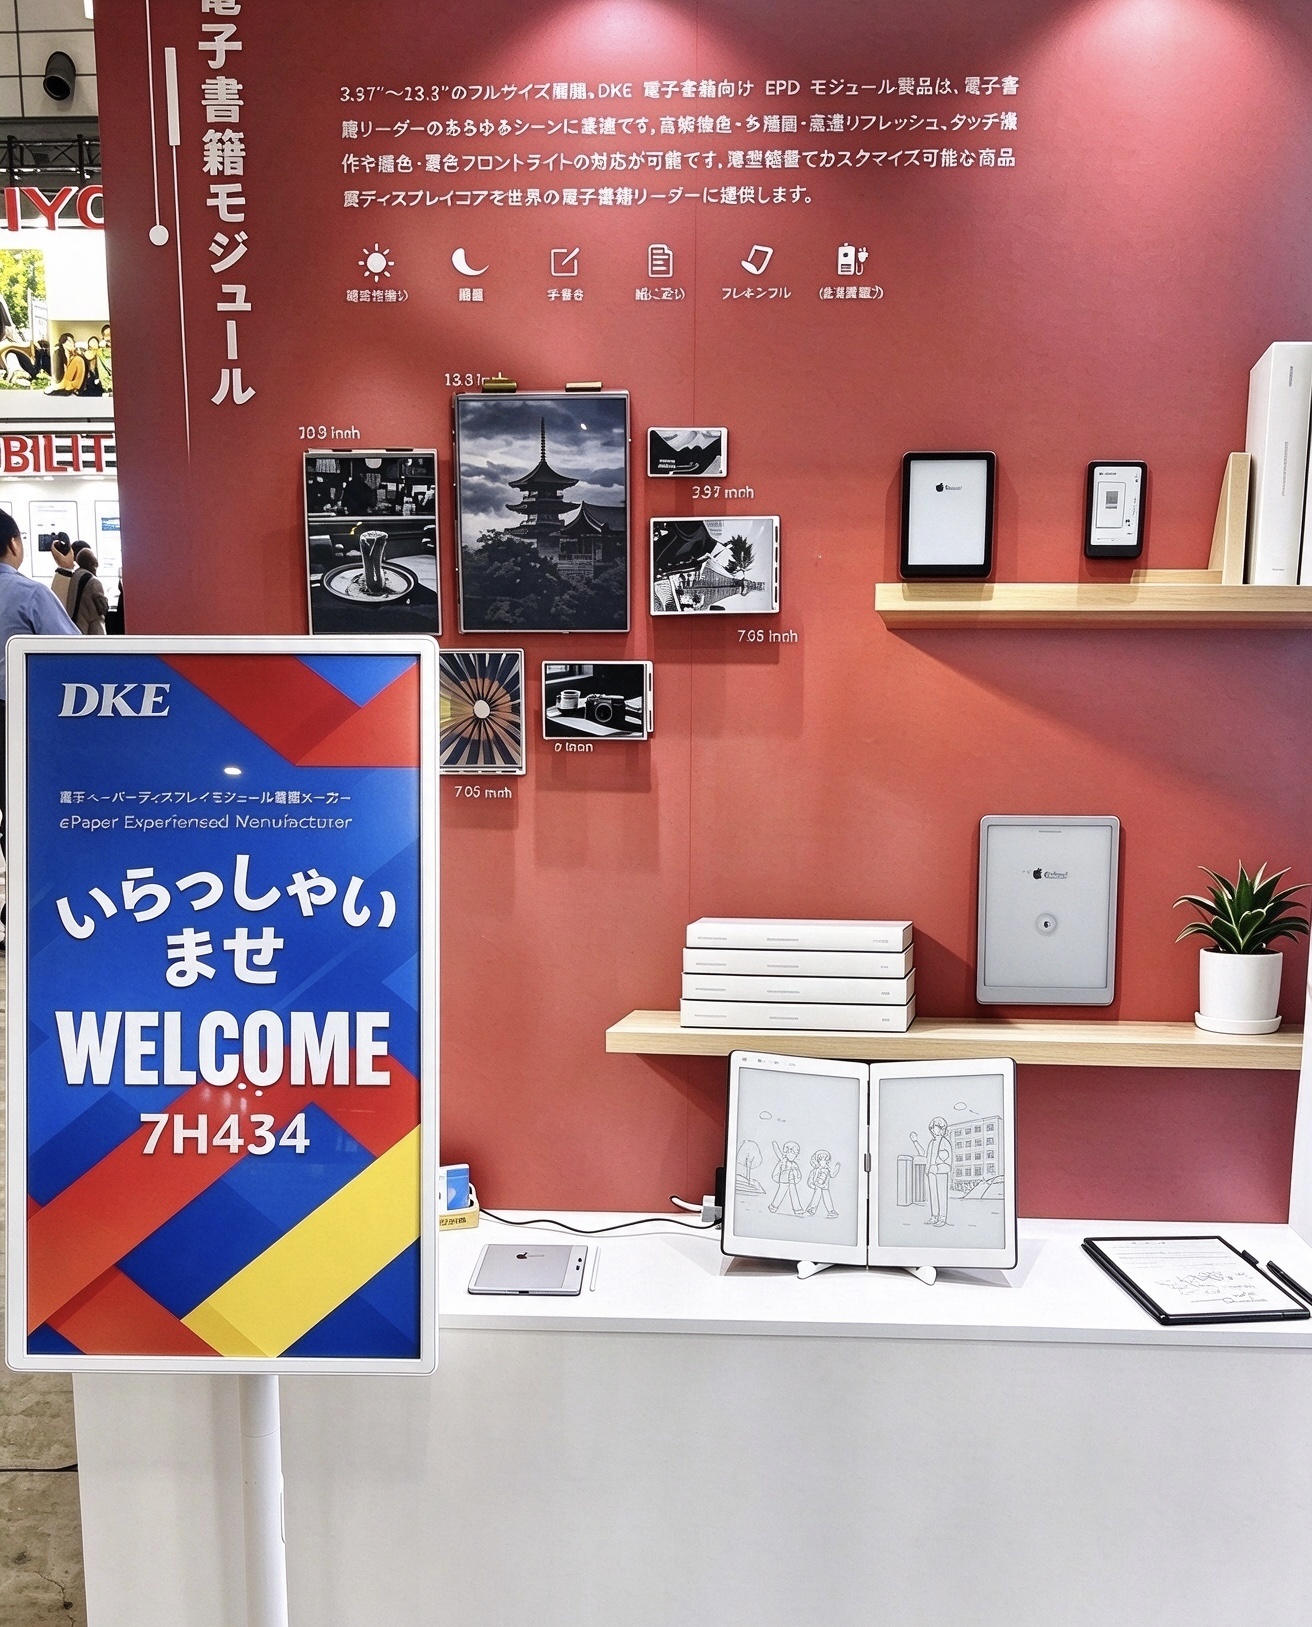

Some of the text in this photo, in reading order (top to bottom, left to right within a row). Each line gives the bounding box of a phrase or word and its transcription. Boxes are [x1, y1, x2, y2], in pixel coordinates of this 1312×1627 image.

[766, 80, 801, 96] EPD
[58, 682, 171, 718] DKE
[56, 854, 397, 940] いらっしゃい
[165, 926, 285, 988] ませ
[55, 1009, 391, 1087] WELCOME
[140, 1112, 311, 1156] 7H434
